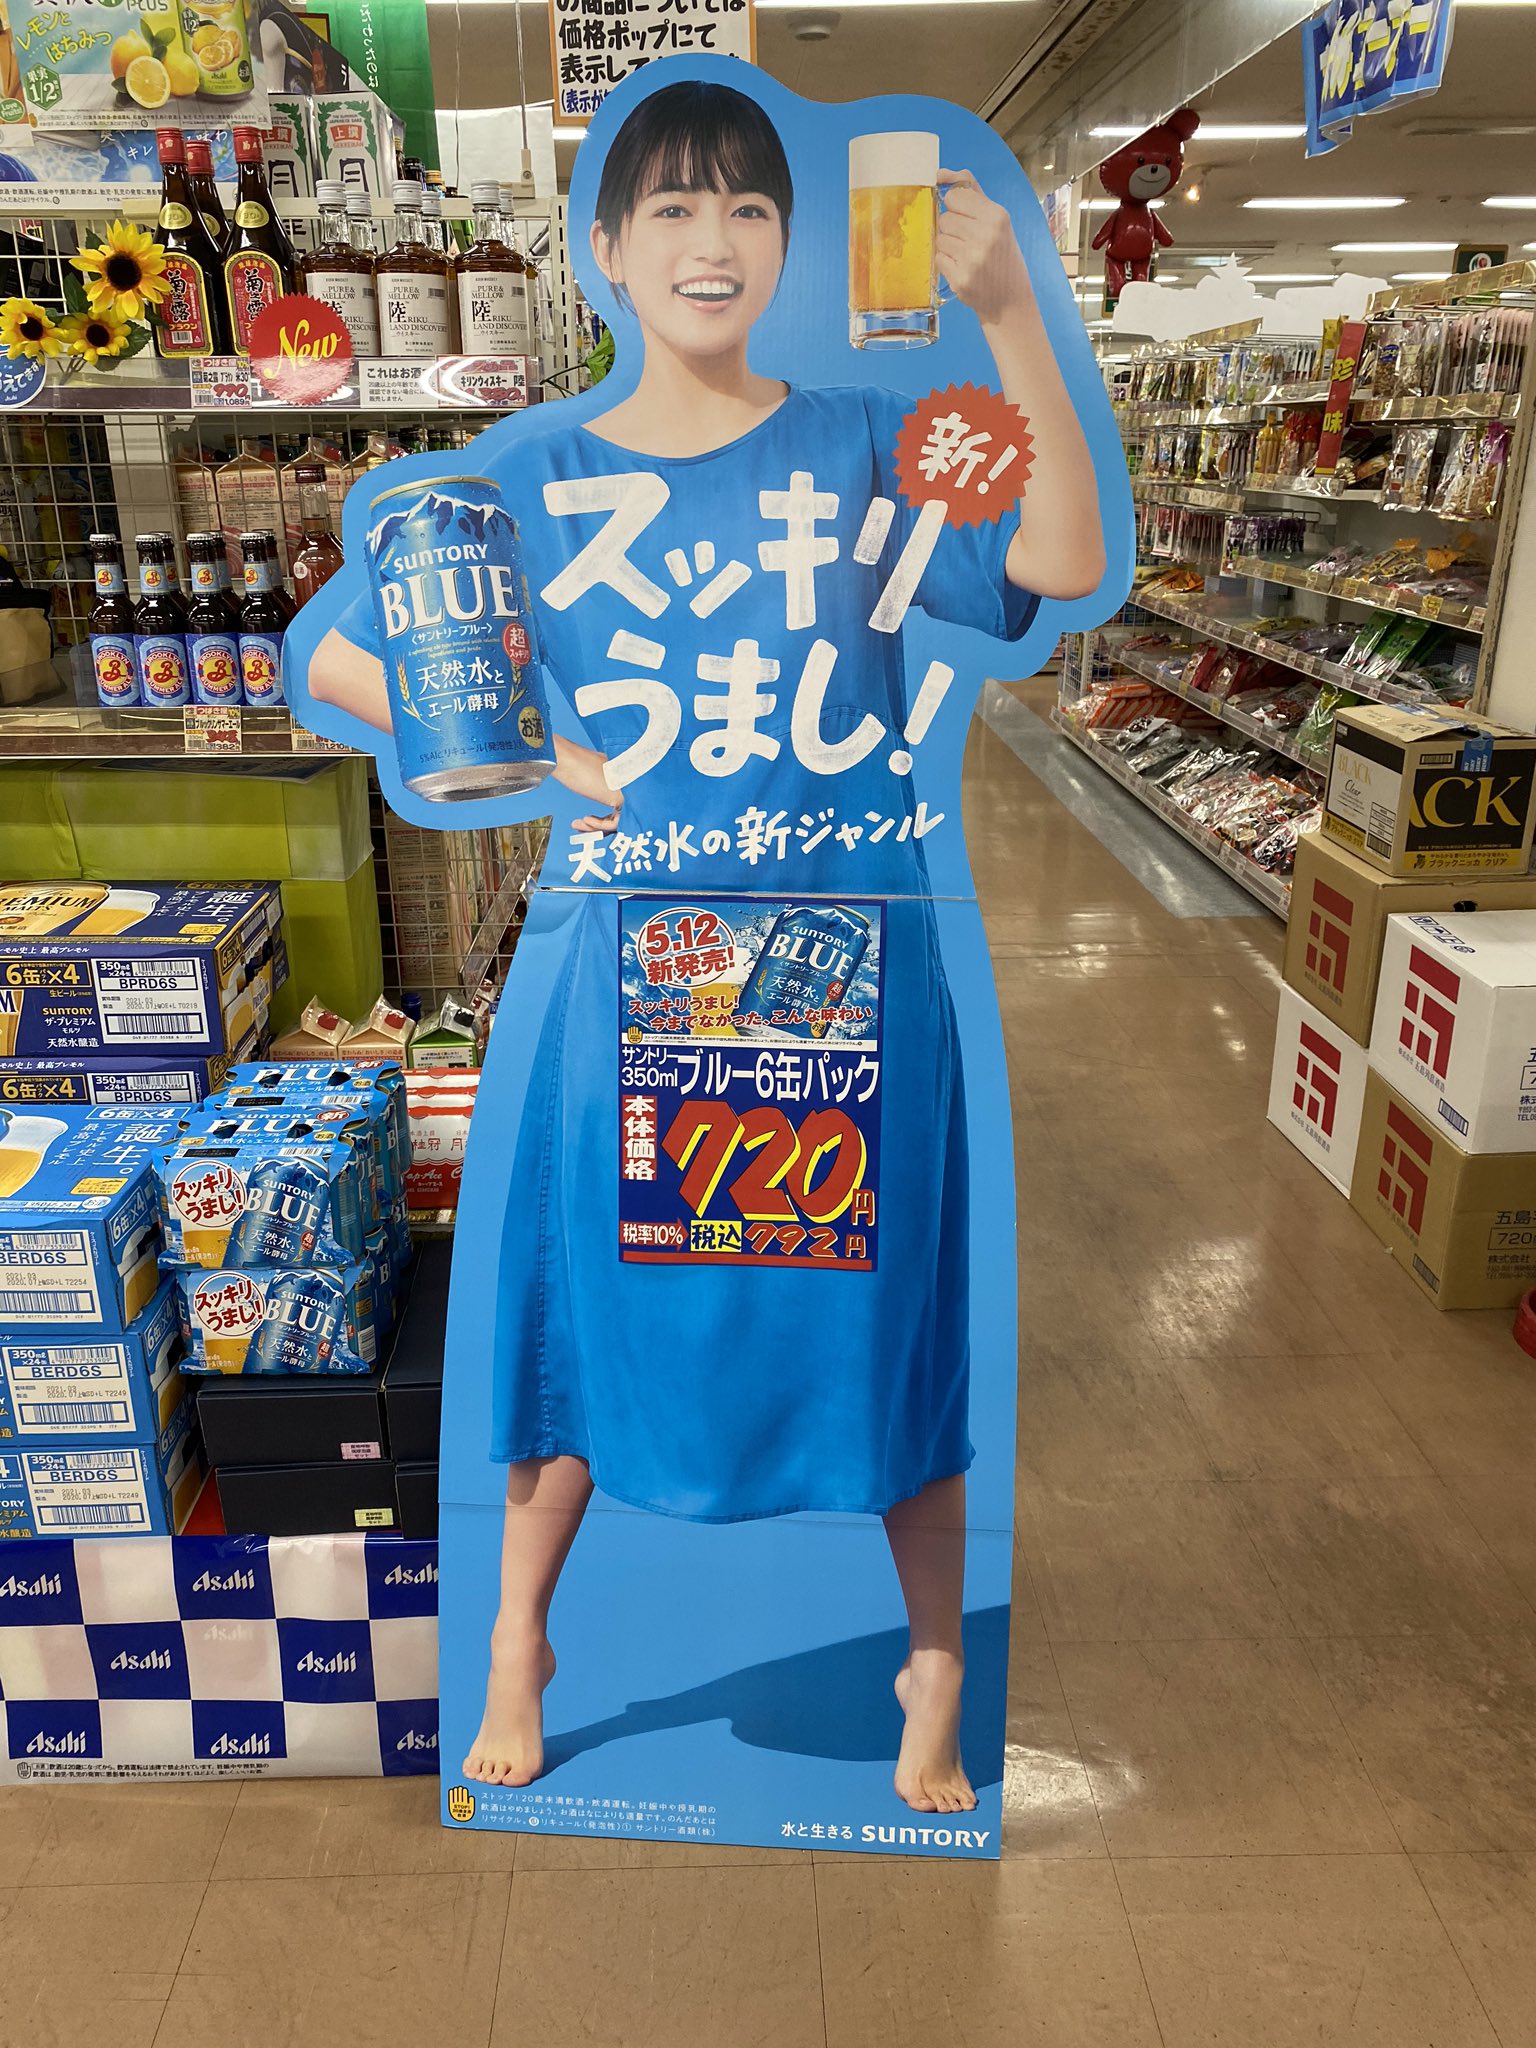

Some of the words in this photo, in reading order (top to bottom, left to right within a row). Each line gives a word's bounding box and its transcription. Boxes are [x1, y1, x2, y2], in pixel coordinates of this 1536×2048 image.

[17, 11, 72, 50] レモンと
[559, 18, 717, 50] 価格ポップにて
[45, 30, 111, 64] はちみつ
[27, 69, 49, 83] 果実
[29, 82, 57, 104] 1/2
[389, 301, 407, 323] 陸
[472, 300, 491, 323] 陸
[264, 318, 342, 379] New
[918, 412, 1018, 494] 新!
[540, 471, 948, 633] スッキリ
[378, 565, 520, 639] BLUE
[509, 627, 526, 649] 超
[416, 657, 505, 695] 天然水と
[428, 694, 500, 718] エール酵母
[575, 629, 954, 791] うまし!
[521, 713, 544, 740] お酒
[568, 802, 945, 883] 天然水の新ジャンル
[0, 895, 97, 909] EMIUM
[645, 914, 721, 955] 5.12
[647, 949, 735, 985] 新発売!
[768, 934, 854, 981] BLUE
[50, 989, 77, 998] 生ビール
[119, 977, 178, 990] BPRD6S
[771, 976, 820, 1002] 天然水と
[42, 1007, 93, 1016] SUNTORY
[629, 995, 739, 1013] スッキリうまし!
[44, 1017, 96, 1026] ザ・プレミアム
[650, 1006, 872, 1030] 今までなかった、こんな味わい
[47, 1038, 100, 1048] 天然水醸造
[622, 1047, 678, 1065] サントリー
[622, 1067, 677, 1087] 350ml
[678, 1048, 879, 1103] ブルー6缶パック
[114, 1091, 172, 1102] BPRD6S
[624, 1096, 656, 1180] 本体価格
[173, 1169, 232, 1202] スッキリ
[407, 1170, 443, 1180] ap-Ace
[185, 1190, 243, 1223] うまし!
[248, 1188, 321, 1231] BLUE
[251, 1229, 296, 1253] 天然水と
[623, 1222, 683, 1245] 税率10%
[692, 1222, 741, 1252] 税込
[249, 1245, 289, 1261] エール酵母
[195, 1280, 252, 1312] スッキリ
[206, 1301, 264, 1334] うまし!
[265, 1299, 336, 1340] BLUE
[270, 1340, 313, 1361] 天然水と
[32, 1365, 102, 1378] BERD6S
[50, 1469, 119, 1482] BERD6S
[0, 1574, 62, 1597] Asahi
[193, 1569, 255, 1592] Asahi
[384, 1563, 438, 1586] Asah
[110, 1649, 171, 1670] Asahi
[297, 1651, 357, 1674] Asahi
[26, 1730, 86, 1754] Asahi
[210, 1732, 270, 1755] Asahi
[397, 1729, 438, 1751] Asa
[781, 1821, 853, 1840] 水と生きる
[861, 1825, 990, 1848] SUNTORY
